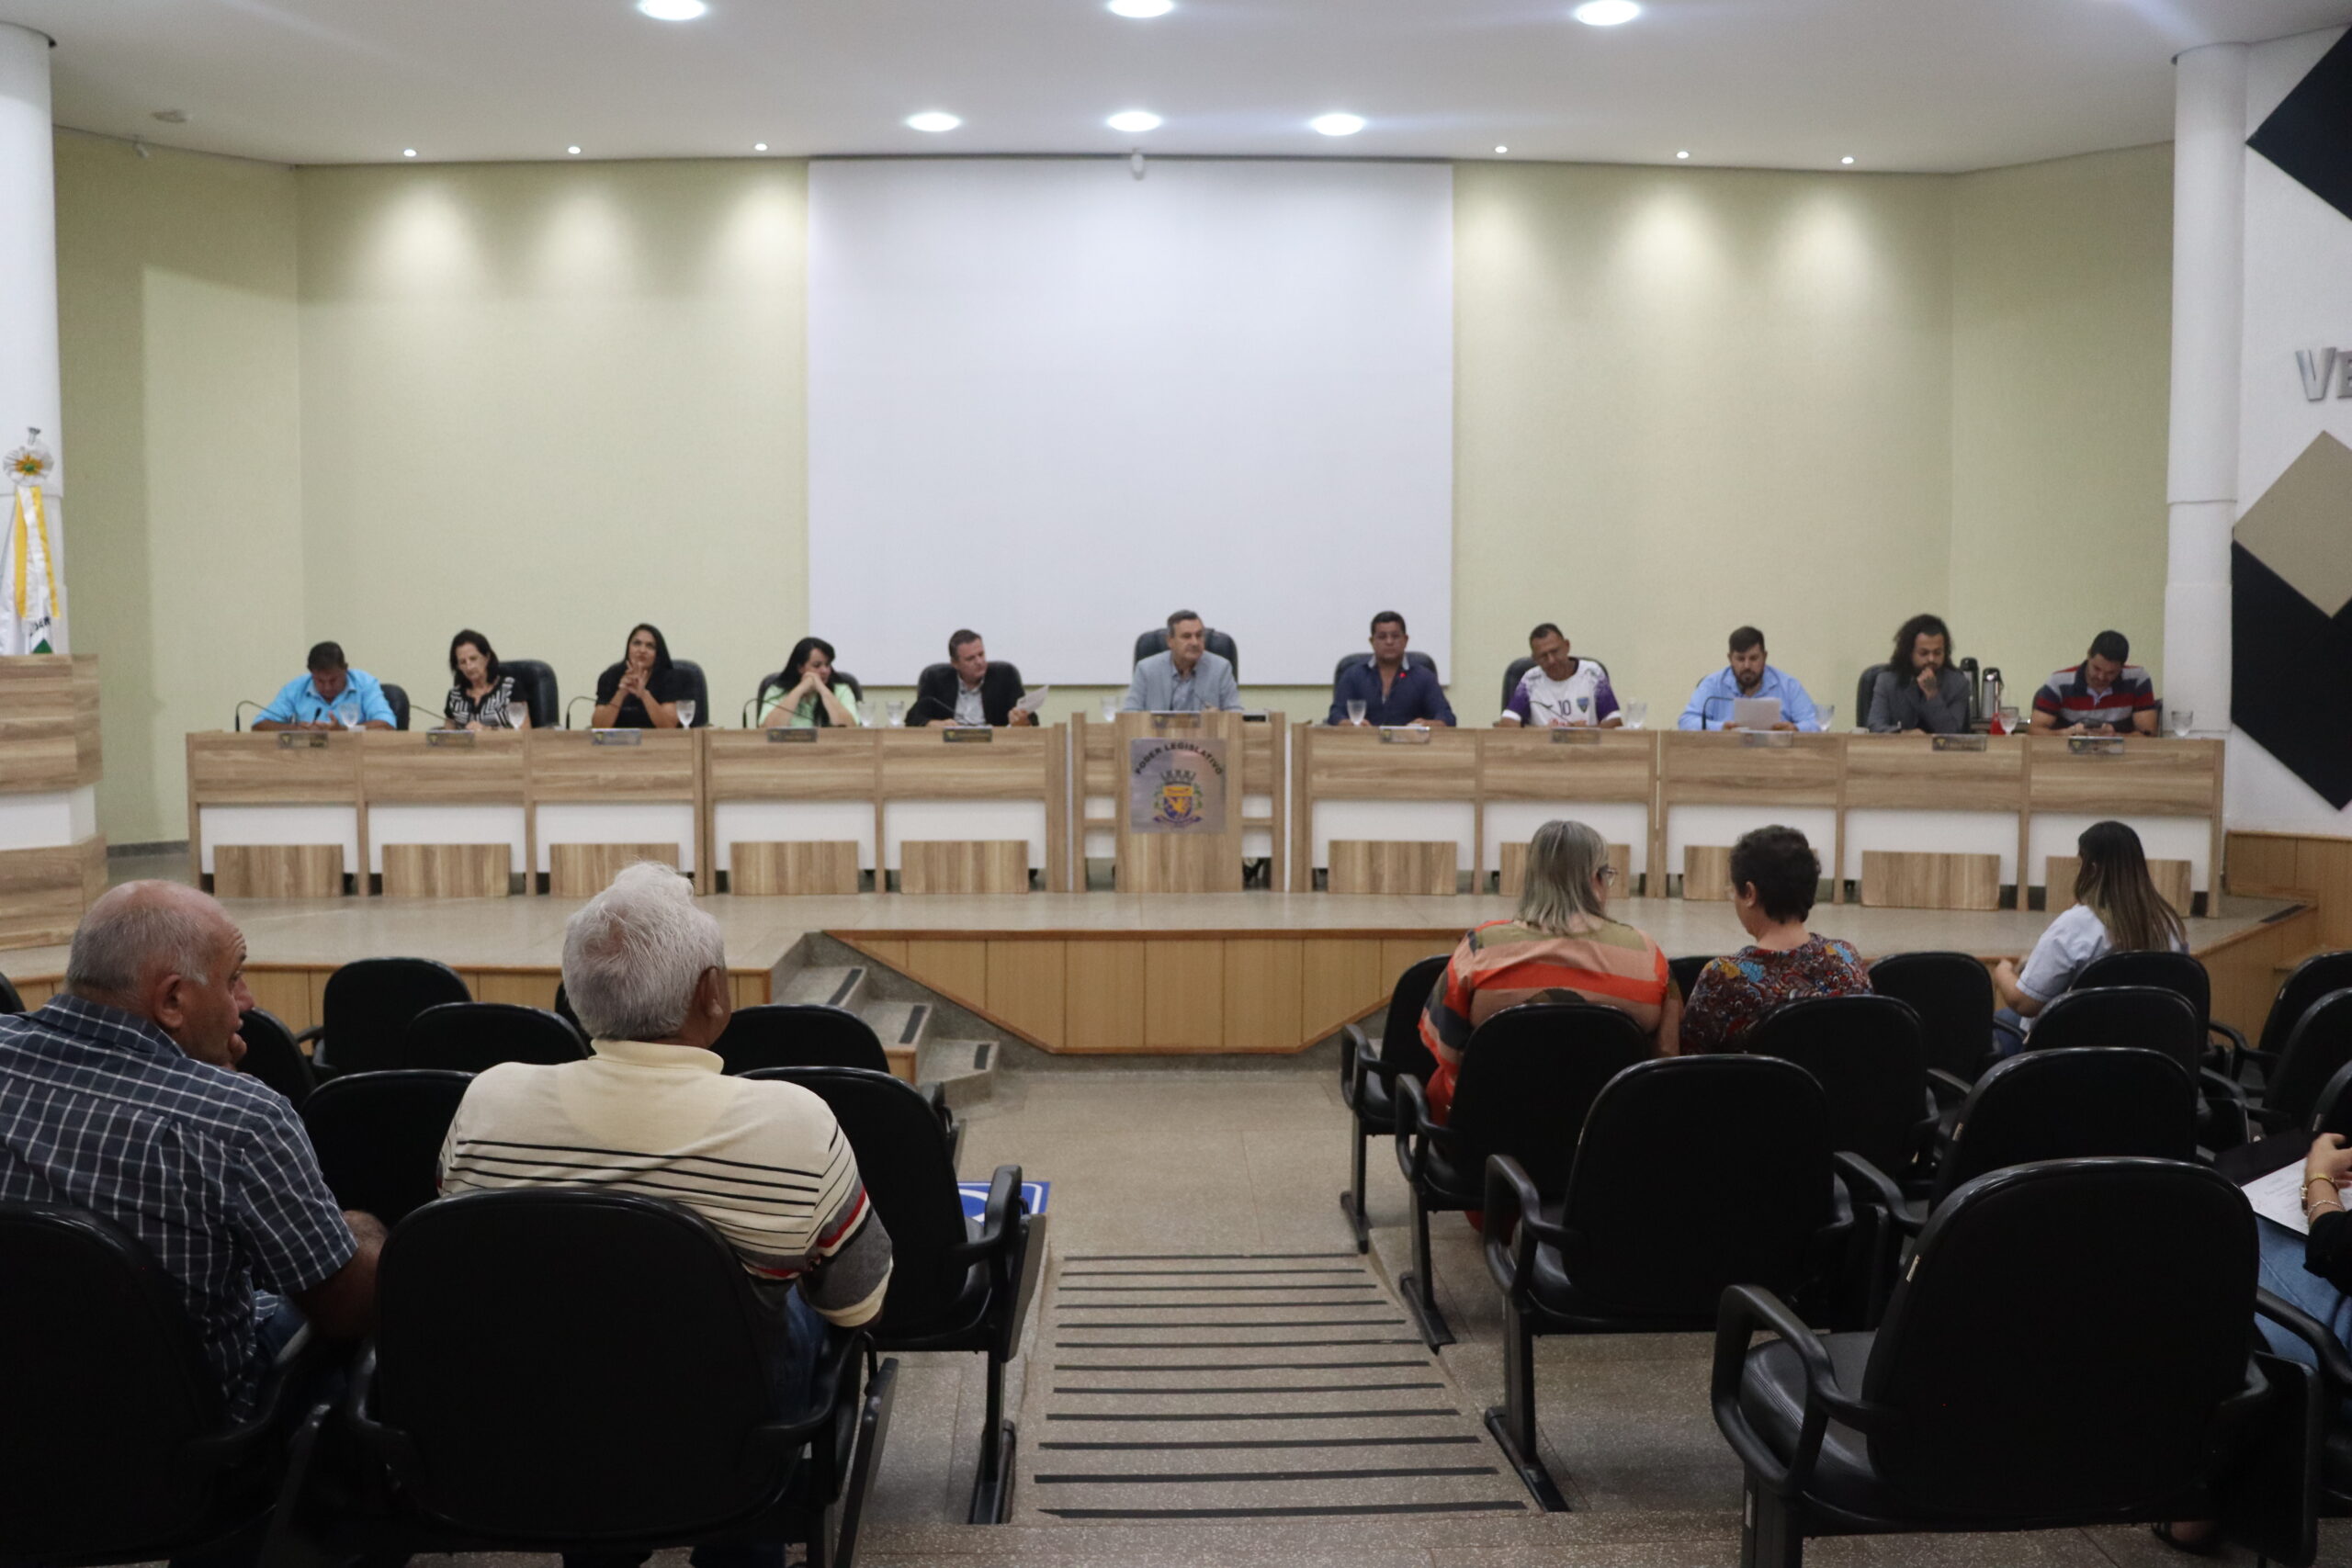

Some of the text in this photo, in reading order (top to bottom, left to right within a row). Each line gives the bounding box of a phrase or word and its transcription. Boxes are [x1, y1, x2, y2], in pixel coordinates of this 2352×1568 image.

[1557, 699, 1571, 716] 10
[1135, 741, 1223, 775] PODER LEGISLATIVO
